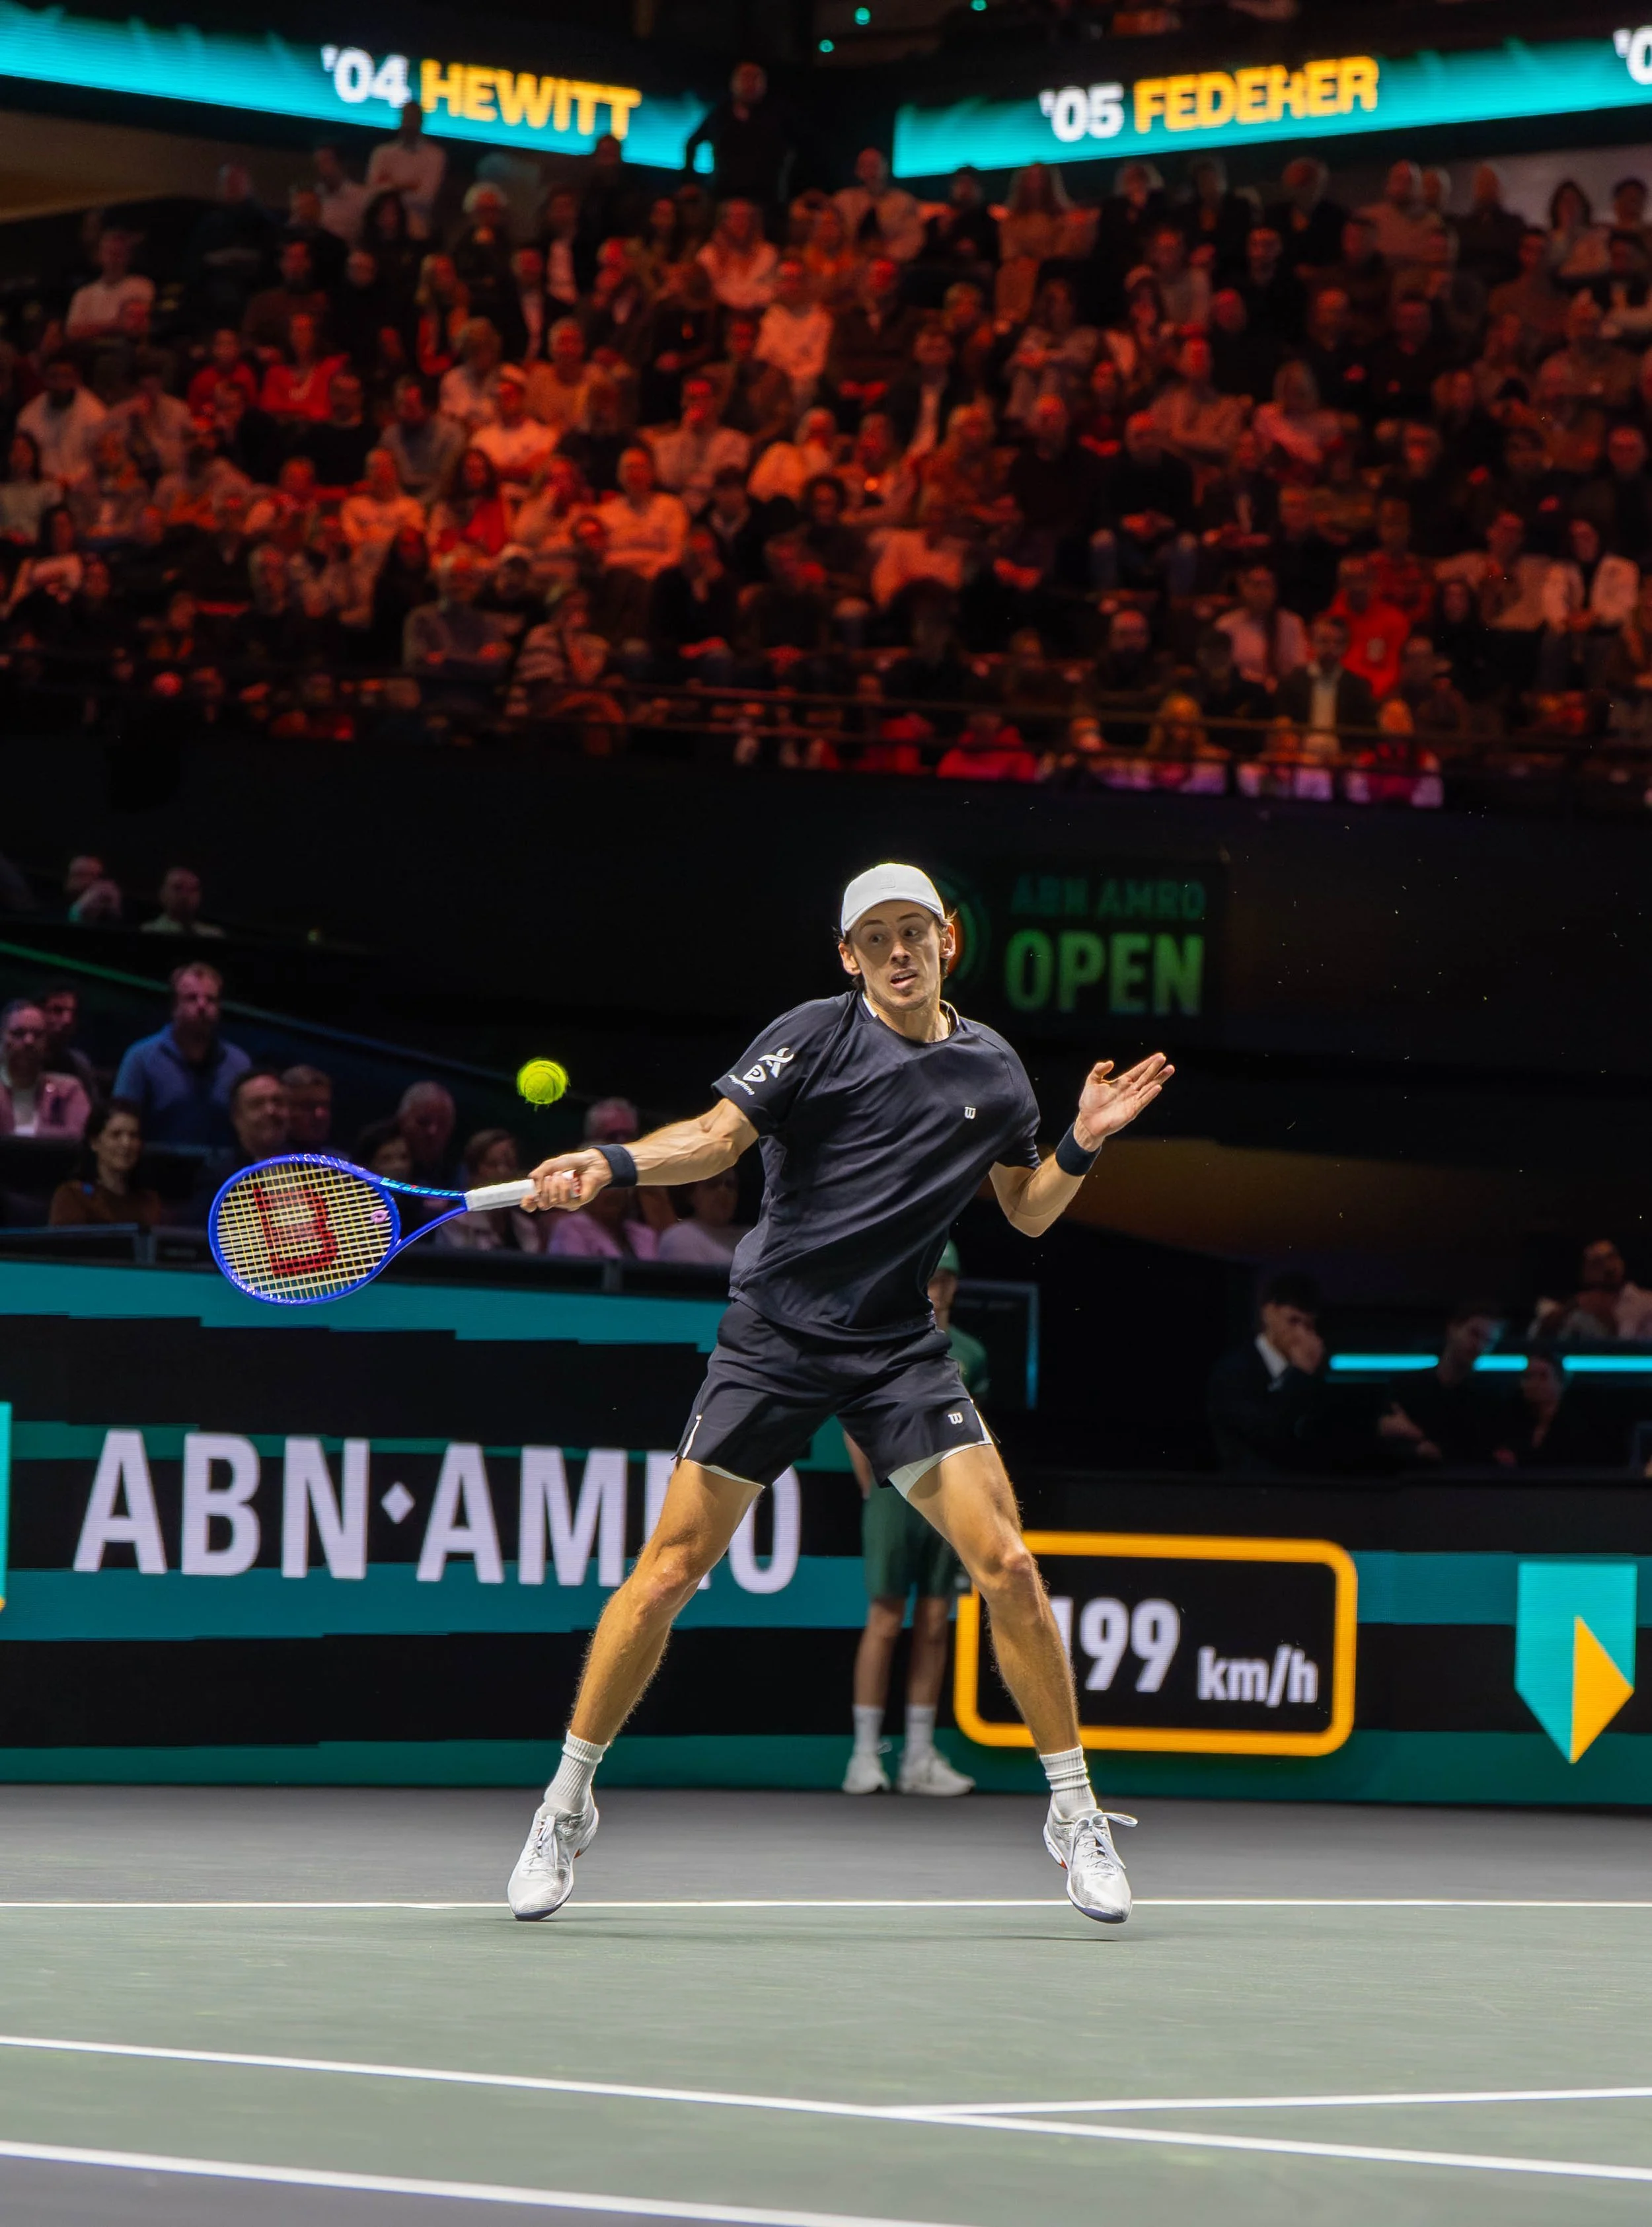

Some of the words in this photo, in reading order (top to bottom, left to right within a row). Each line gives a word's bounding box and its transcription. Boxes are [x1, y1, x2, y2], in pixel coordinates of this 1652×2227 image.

[320, 44, 412, 108] '04
[419, 58, 642, 140] HEWITT
[1039, 82, 1124, 142] '05
[1004, 928, 1204, 1016] OPEN
[73, 1429, 371, 1579] ABN
[416, 1442, 802, 1595] AMO
[1197, 1643, 1318, 1708] km/h
